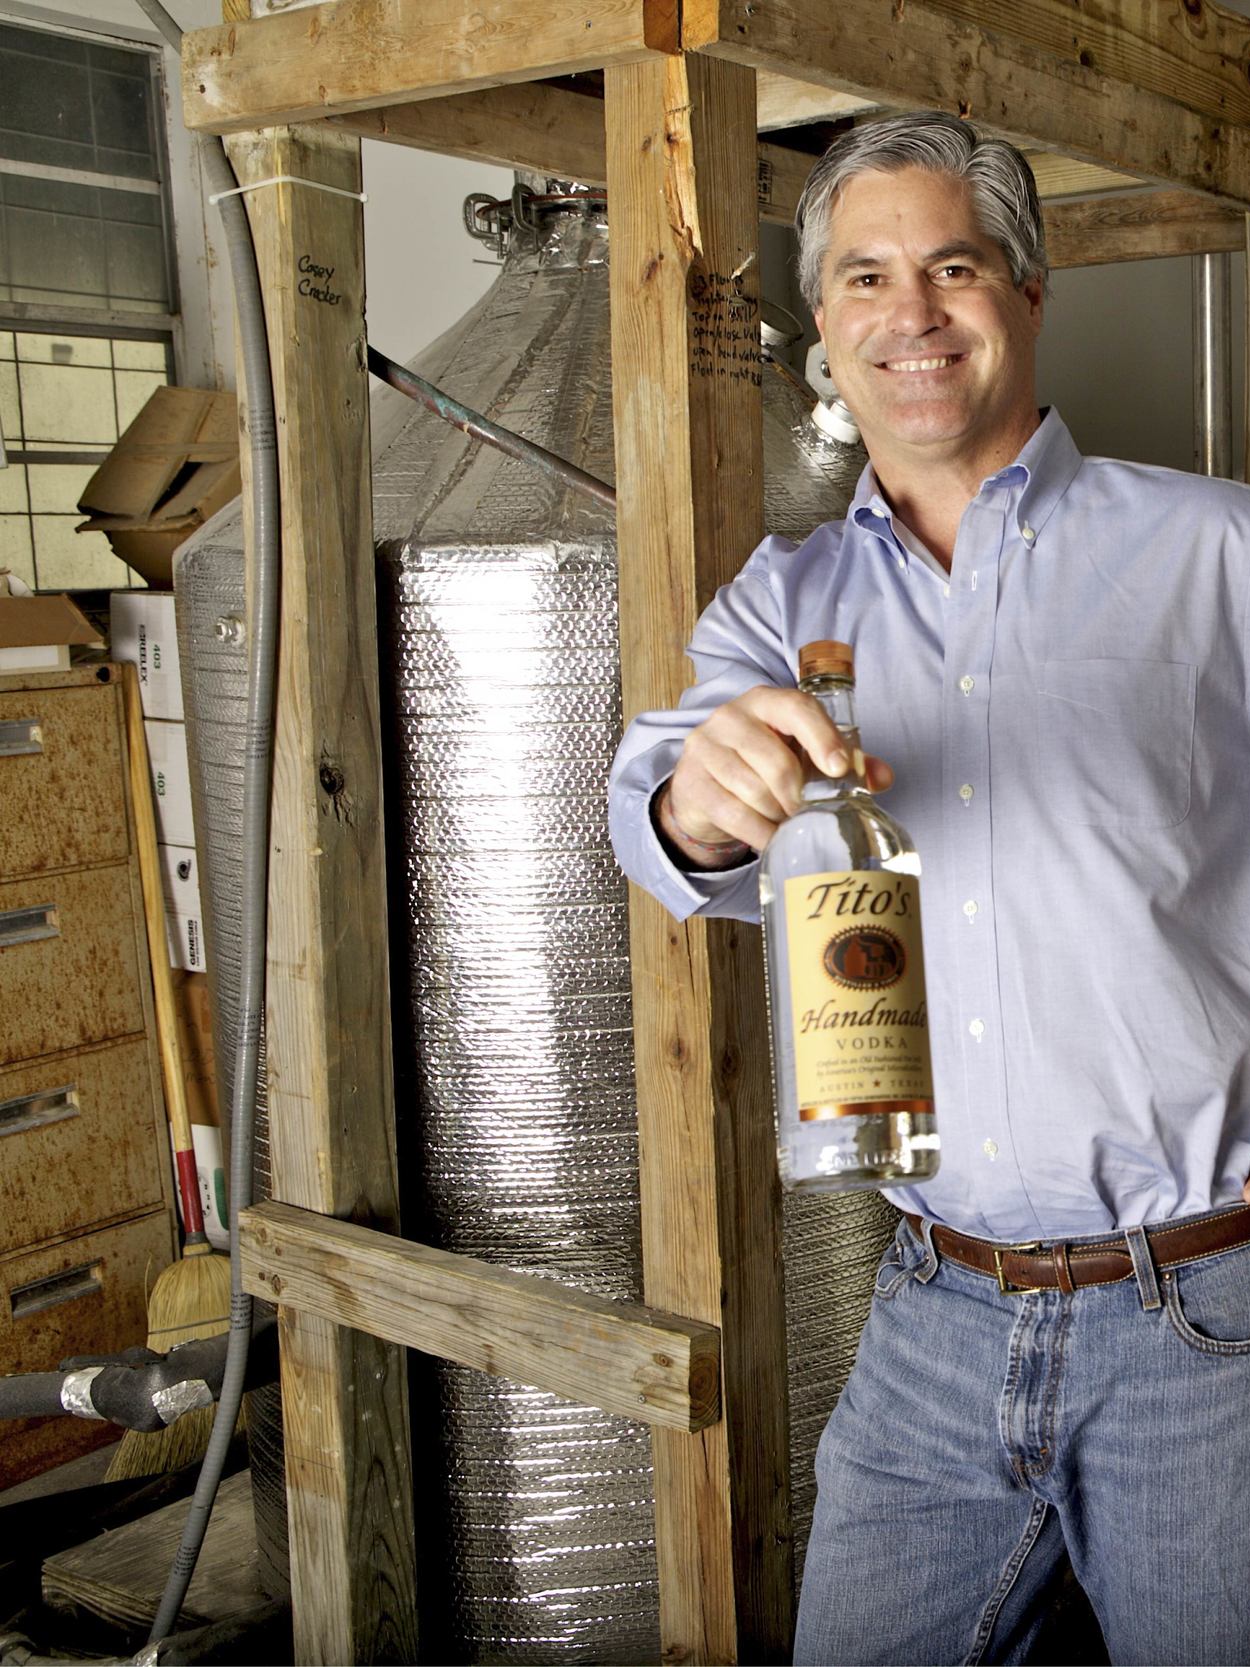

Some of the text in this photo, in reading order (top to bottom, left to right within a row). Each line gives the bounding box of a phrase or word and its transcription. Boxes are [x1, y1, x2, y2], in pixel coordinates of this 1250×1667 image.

[153, 644, 161, 669] 403
[157, 771, 166, 797] 403
[807, 877, 911, 920] Tito's
[187, 919, 196, 966] GENESIS
[836, 1035, 908, 1051] VODKA
[819, 1082, 865, 1093] AUSTIN
